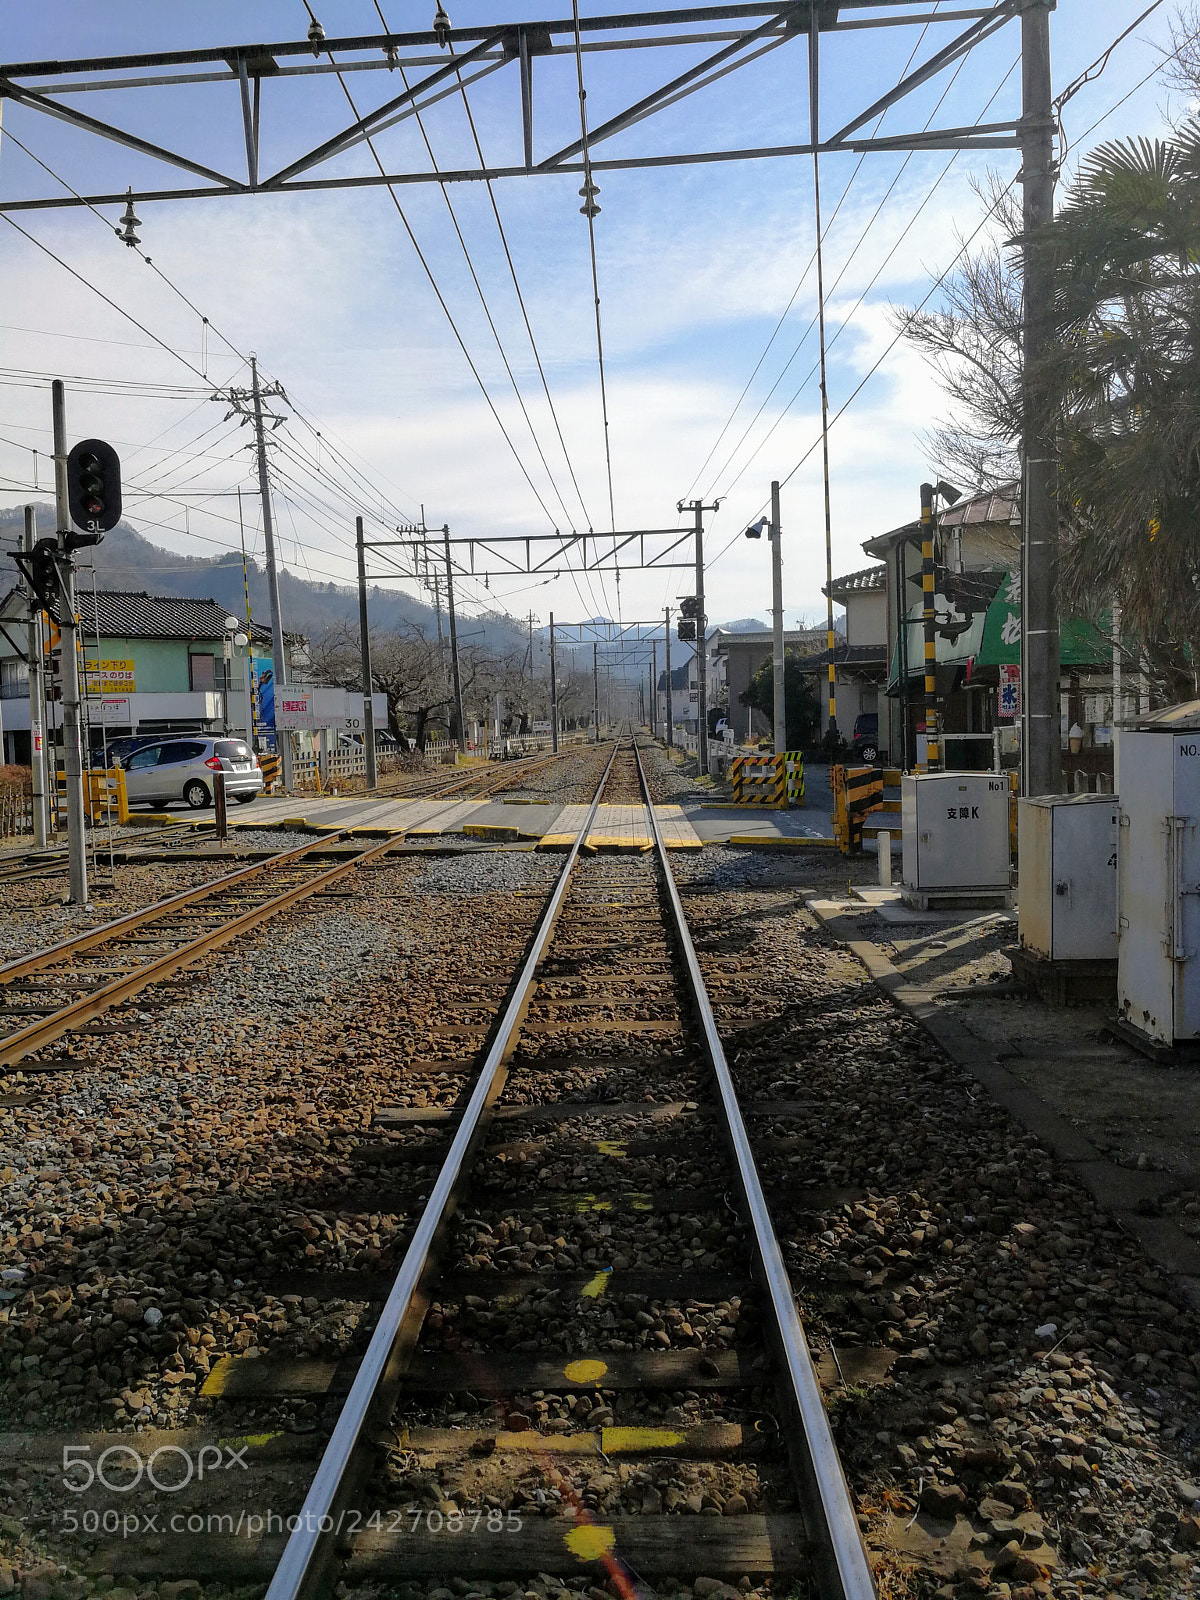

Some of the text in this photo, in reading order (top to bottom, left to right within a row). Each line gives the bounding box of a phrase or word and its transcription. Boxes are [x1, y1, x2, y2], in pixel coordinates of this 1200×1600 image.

[87, 520, 105, 531] 3L
[1002, 684, 1017, 704] 氷
[345, 719, 360, 729] 30
[988, 781, 1005, 791] No1
[947, 806, 980, 820] 支障K
